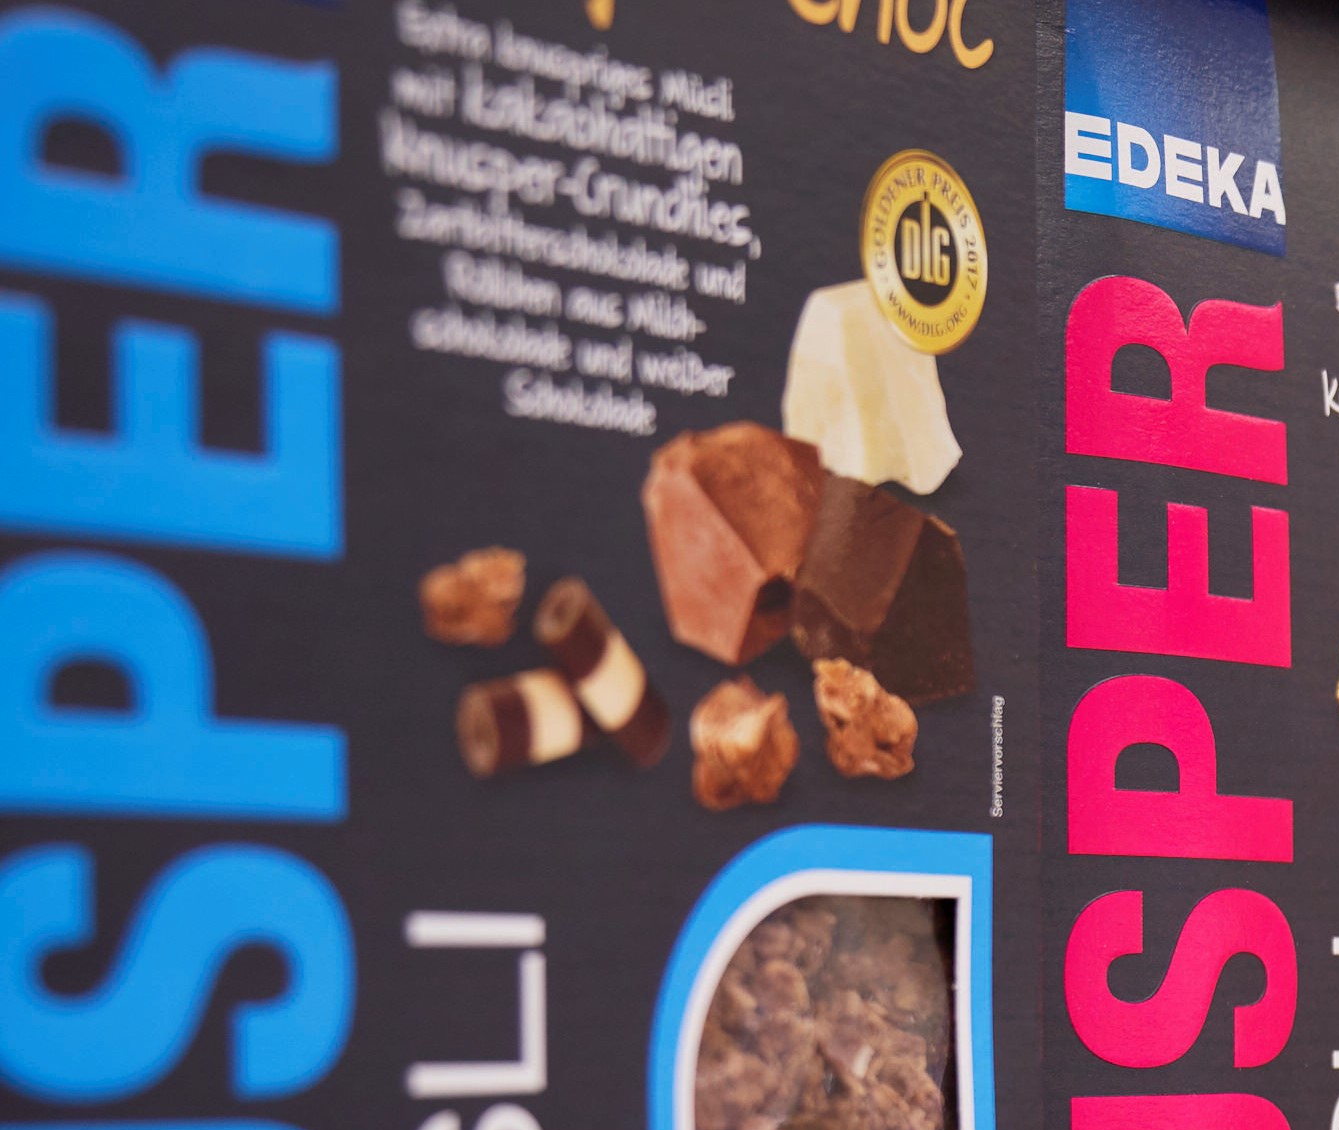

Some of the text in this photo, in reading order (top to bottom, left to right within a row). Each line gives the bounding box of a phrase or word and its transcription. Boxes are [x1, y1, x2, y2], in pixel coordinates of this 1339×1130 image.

[1063, 110, 1287, 226] EDEKA
[901, 190, 951, 287] DLG
[932, 172, 972, 229] PREIS
[964, 237, 980, 291] 2017
